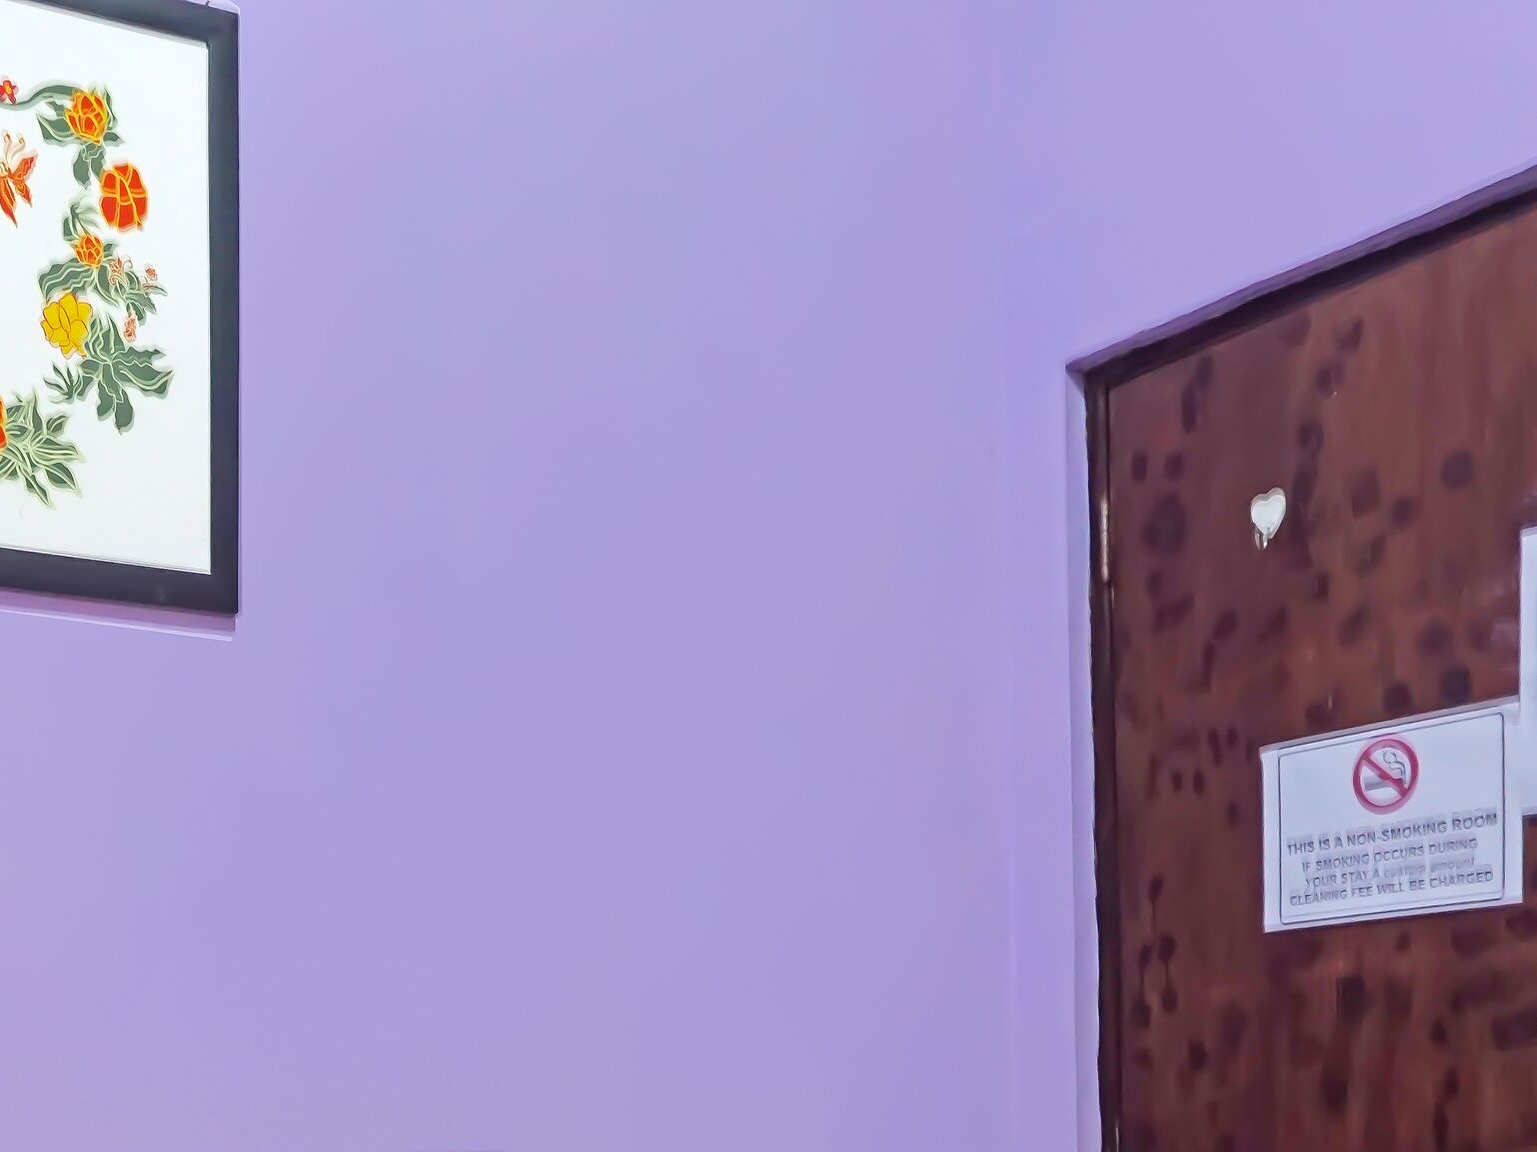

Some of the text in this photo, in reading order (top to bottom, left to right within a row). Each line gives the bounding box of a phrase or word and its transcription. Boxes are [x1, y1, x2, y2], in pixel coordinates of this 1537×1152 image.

[1287, 813, 1497, 856] THIS IS A NON-SMOKING ROOM
[1302, 838, 1478, 872] IF SMOKING OCCURS DURING
[1289, 871, 1494, 906] CLEANING FEE WILL BE CHARGED
[1306, 874, 1337, 888] YOUR
[1341, 870, 1368, 884] STAY
